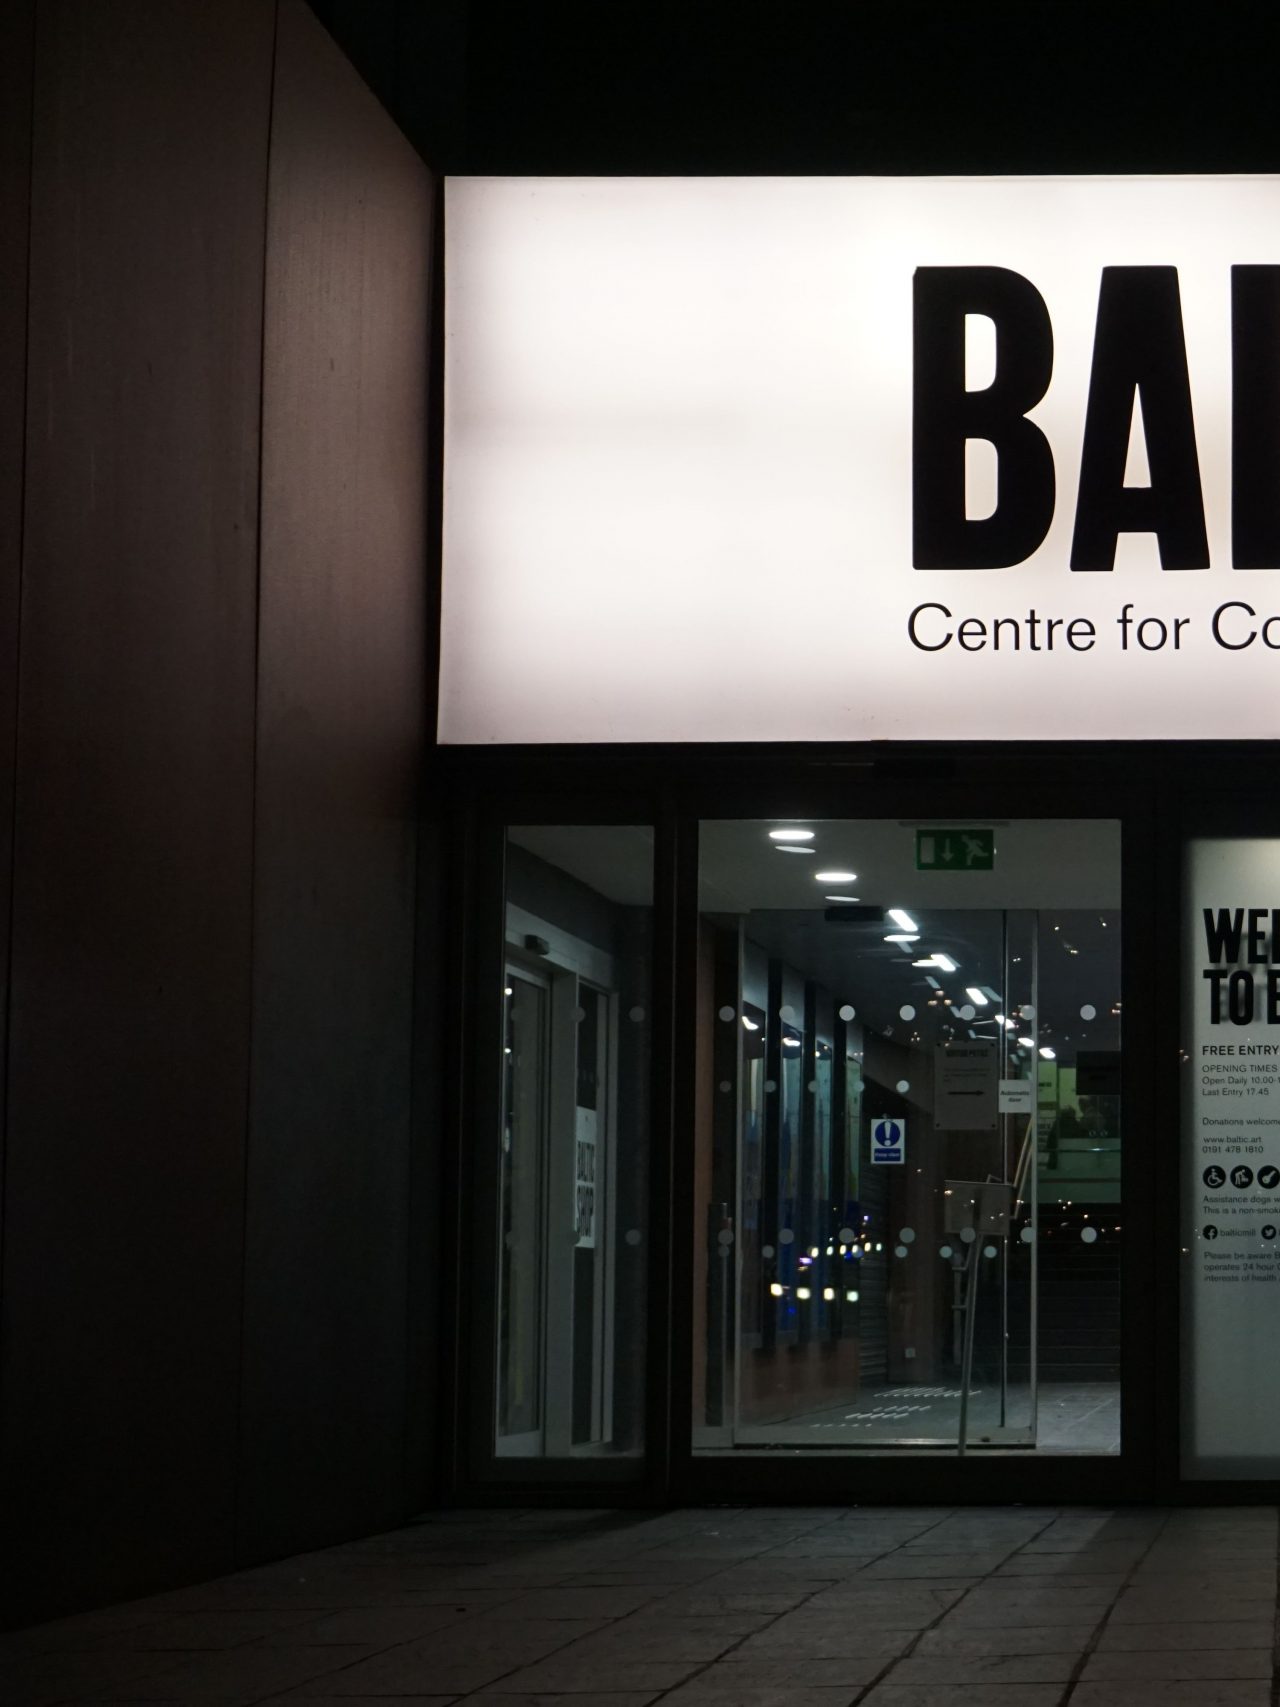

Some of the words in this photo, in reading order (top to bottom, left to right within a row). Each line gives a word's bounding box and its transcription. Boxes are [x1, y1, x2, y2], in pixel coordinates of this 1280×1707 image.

[907, 602, 1095, 652] Centre
[1117, 603, 1190, 651] for
[1203, 969, 1254, 1026] TO
[1202, 1045, 1235, 1056] FREE
[1239, 1045, 1280, 1056] ENTRY
[1202, 1064, 1247, 1073] OPENING
[1250, 1064, 1278, 1073] TIMES
[1202, 1076, 1225, 1086] Open
[1228, 1076, 1248, 1086] Daily
[1202, 1088, 1219, 1096] Last
[1222, 1088, 1243, 1097] Entry
[1202, 1117, 1244, 1126] Donations
[1203, 1136, 1262, 1144] www.baltic.art
[1202, 1145, 1221, 1154] 0191
[1225, 1145, 1241, 1154] 478
[1245, 1145, 1264, 1154] 1810
[1203, 1195, 1248, 1203] Assistance
[1250, 1195, 1271, 1205] dogs
[1203, 1207, 1220, 1215] This
[1222, 1207, 1230, 1215] is
[1204, 1251, 1231, 1259] Please
[1234, 1251, 1245, 1259] be
[1204, 1264, 1240, 1272] operates
[1256, 1263, 1274, 1271] hour
[1241, 1274, 1250, 1282] of
[1251, 1274, 1276, 1282] health
